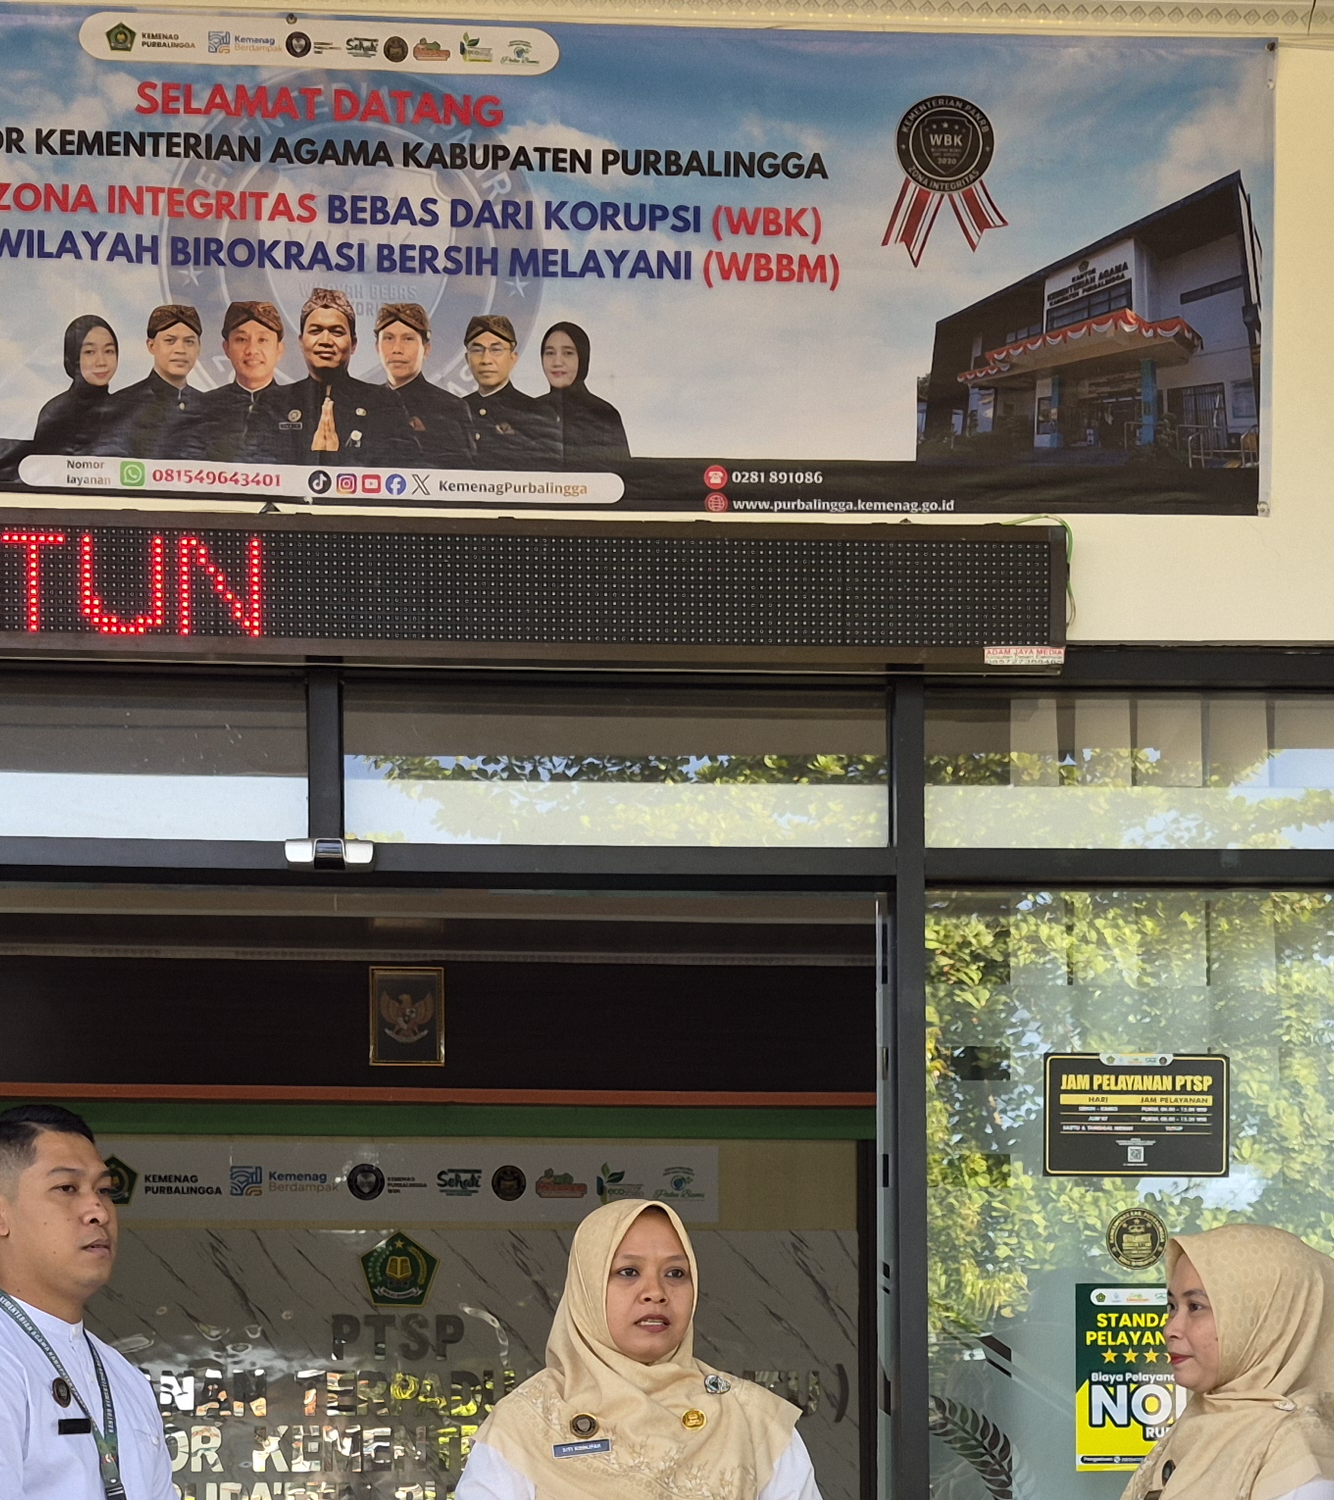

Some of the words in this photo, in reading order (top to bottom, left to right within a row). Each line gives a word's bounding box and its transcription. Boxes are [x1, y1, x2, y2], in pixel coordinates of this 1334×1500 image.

[135, 81, 323, 121] SELAMAT
[333, 89, 503, 128] DATANG
[929, 133, 963, 146] WBK
[35, 128, 261, 162] KEMENTERIAN
[269, 138, 394, 168] AGAMA
[402, 141, 592, 174] KABUPATEN
[601, 149, 829, 180] PURBALINGGA
[108, 185, 317, 223] INTEGRITAS
[327, 194, 440, 227] BEBAS
[449, 199, 533, 230] DARI
[544, 200, 701, 234] KORUPSI
[712, 205, 822, 244] (WBK)
[170, 237, 366, 272] BIROKRASI
[376, 245, 498, 277] BERSIH
[509, 248, 692, 281] MELAYANI
[702, 250, 840, 291] (WBBM)
[66, 459, 105, 471] Nomor
[152, 467, 283, 487] 081549643401
[731, 469, 766, 485] 0281
[769, 470, 823, 486] 891086
[438, 479, 589, 498] KemenagPurbalingga
[733, 497, 955, 517] www.purbalingga.kemenag.go.id
[1060, 1074, 1090, 1091] JAM
[1093, 1074, 1173, 1092] PELAYANAN
[1175, 1075, 1213, 1092] PTSP
[144, 1174, 199, 1185] KEMENAG
[268, 1171, 327, 1184] Kemenag
[144, 1185, 223, 1196] PURBALINGGA
[268, 1182, 340, 1194] Berdampak
[331, 1313, 465, 1361] PTSP
[1091, 1372, 1124, 1385] Biaya
